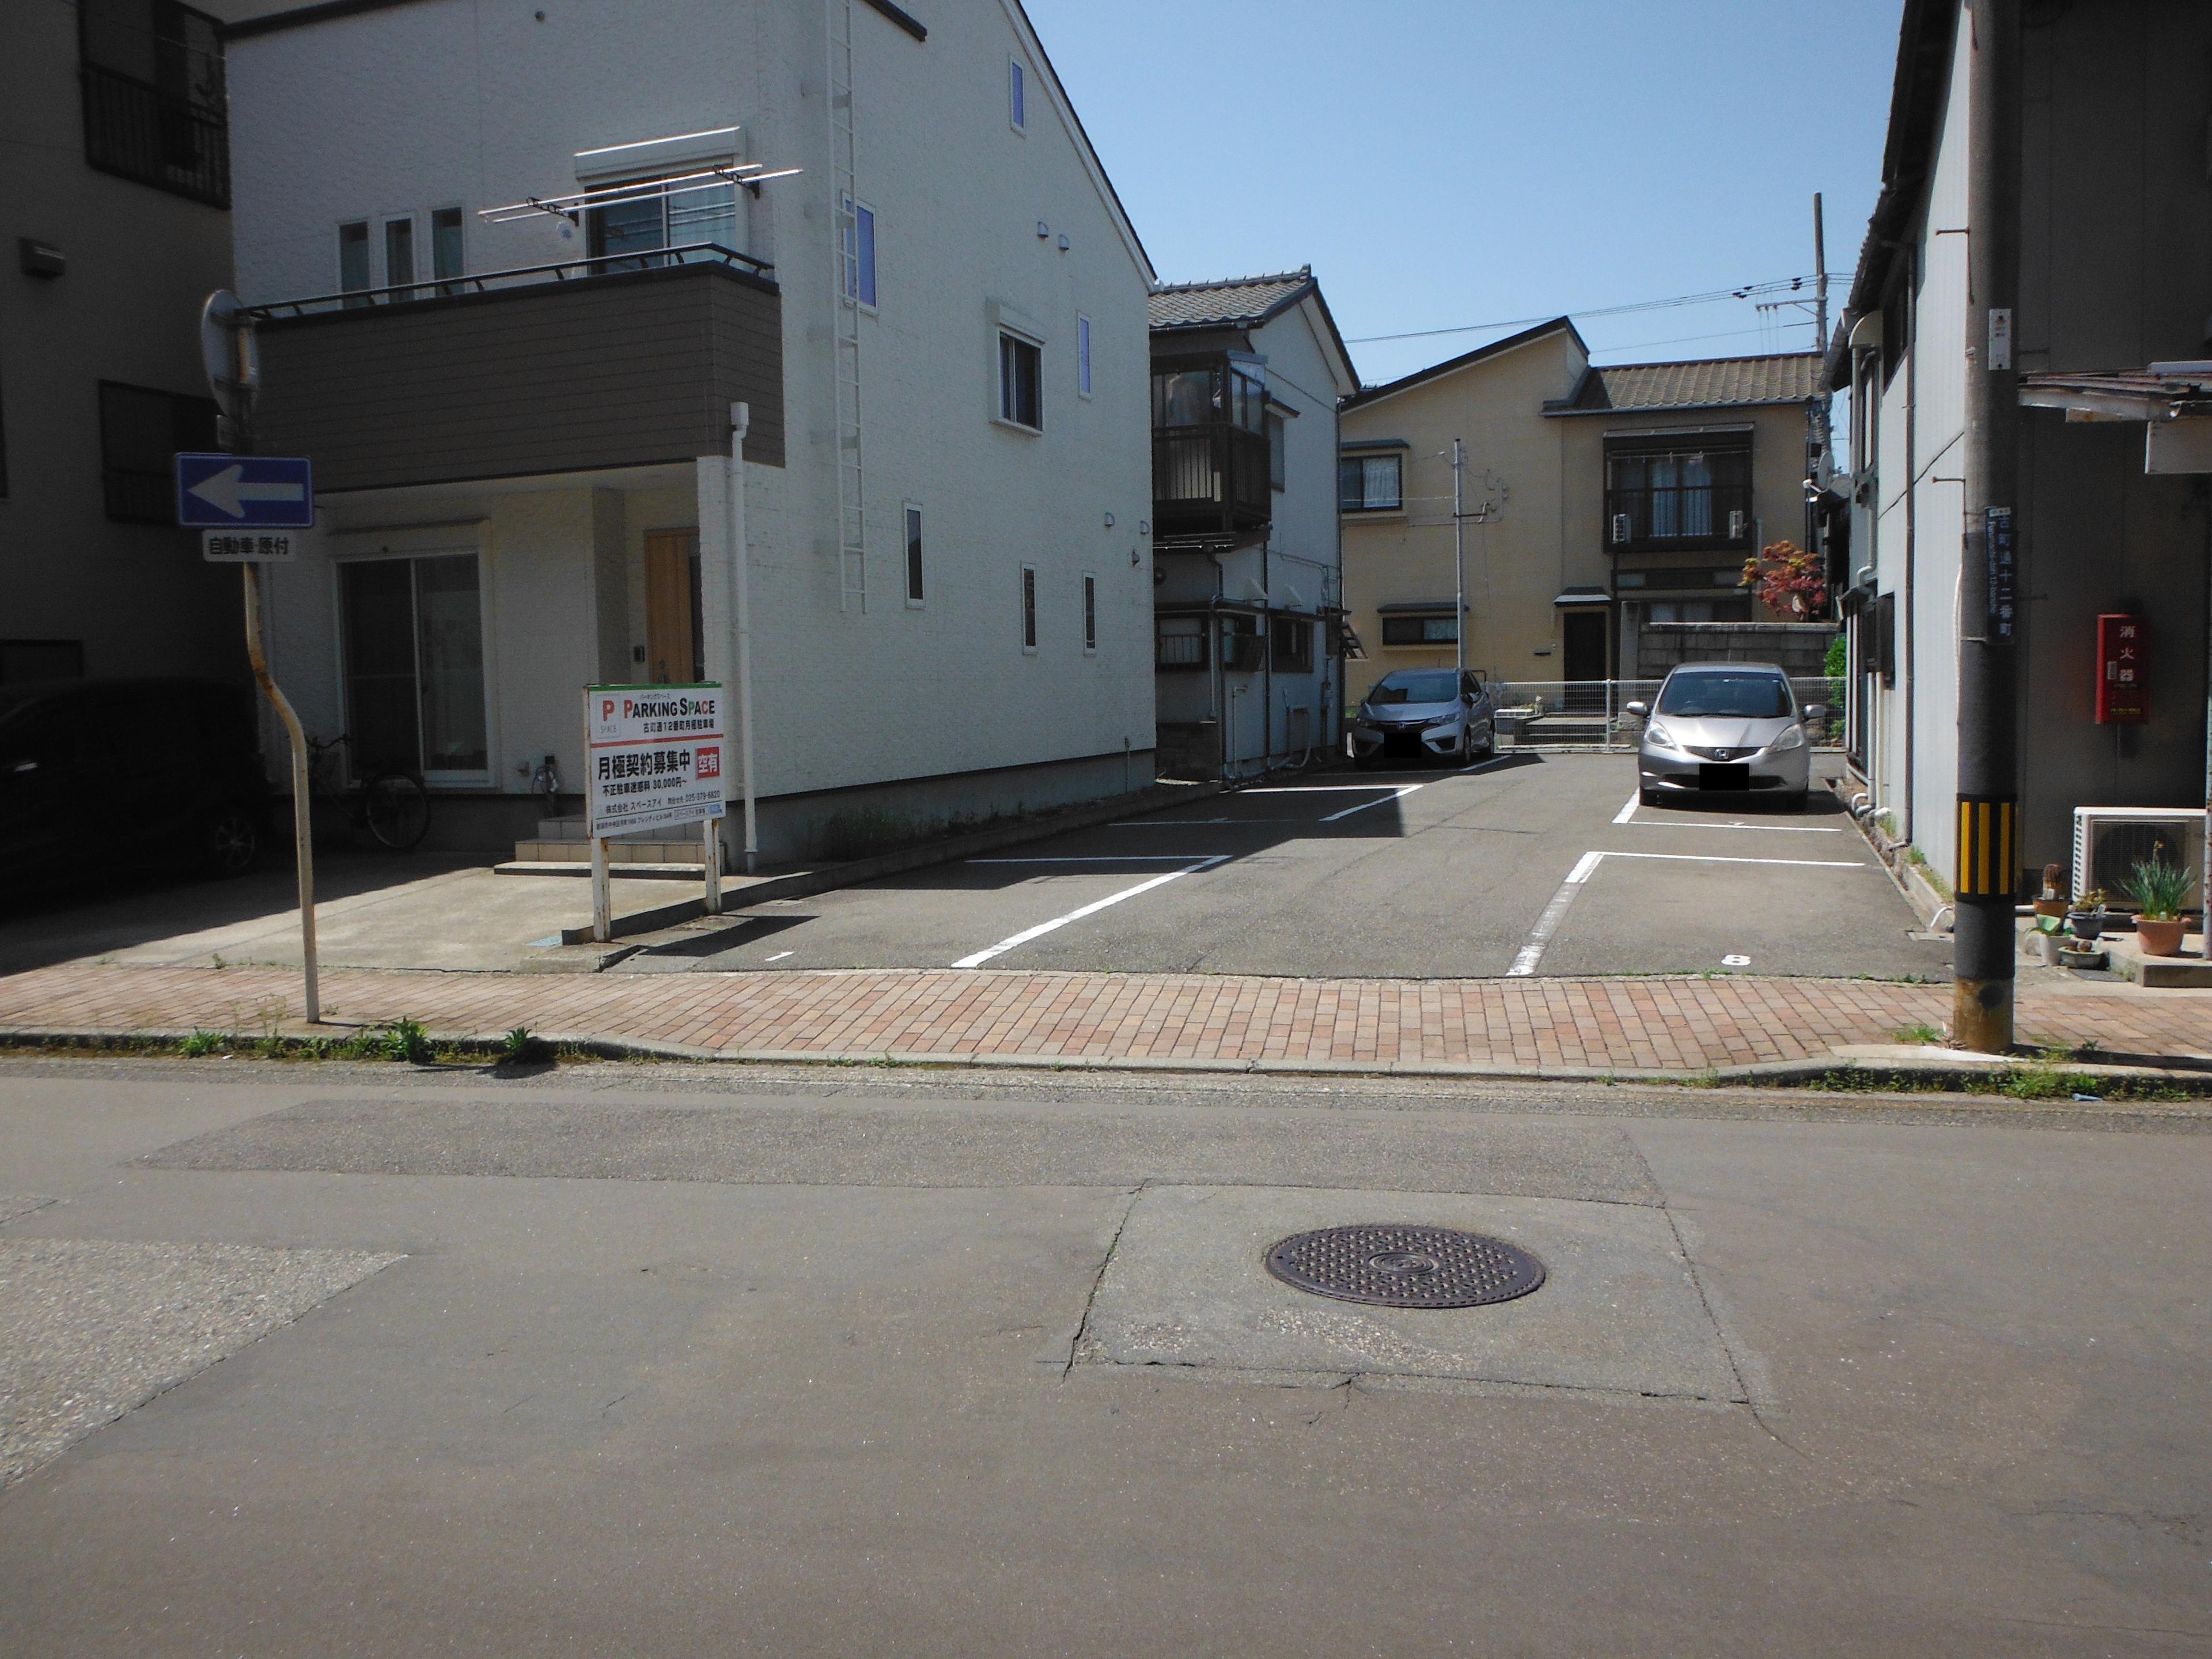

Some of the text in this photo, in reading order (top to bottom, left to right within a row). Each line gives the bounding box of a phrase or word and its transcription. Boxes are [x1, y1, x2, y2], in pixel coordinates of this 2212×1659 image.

[2119, 625, 2136, 682] 消火器
[624, 698, 715, 719] PARKING SPACE
[598, 749, 691, 781] 月極契約募集中
[698, 753, 718, 774] 空有
[606, 802, 628, 814] 株式会社
[1721, 954, 1751, 966] 8
